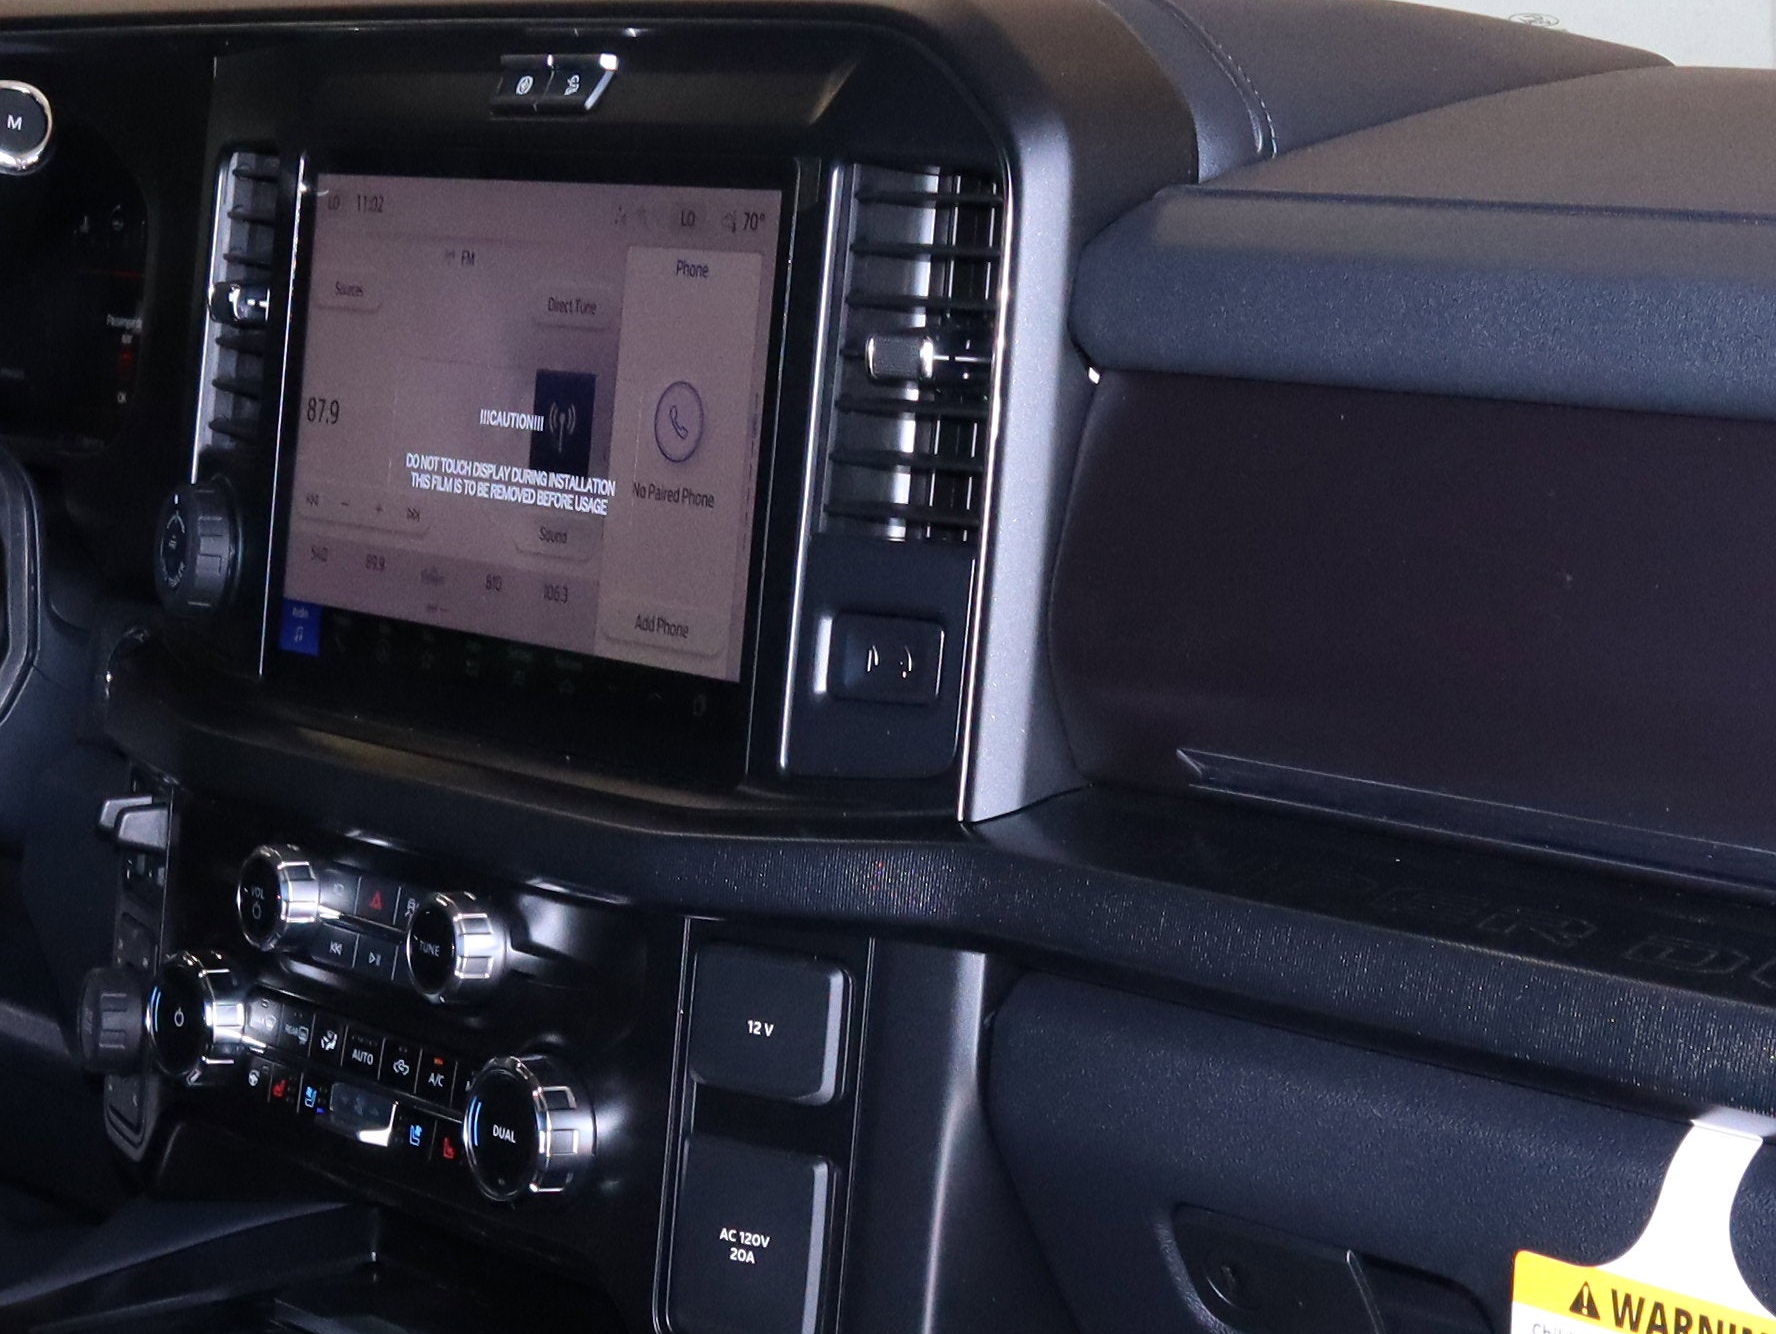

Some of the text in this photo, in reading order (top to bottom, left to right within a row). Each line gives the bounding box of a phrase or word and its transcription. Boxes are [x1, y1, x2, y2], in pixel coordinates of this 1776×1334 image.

[6, 113, 23, 131] M
[357, 194, 384, 213] 11:02
[680, 210, 696, 228] LO
[461, 249, 476, 267] FM
[675, 259, 710, 279] Phone
[334, 280, 364, 298] Sources
[547, 296, 597, 316] Direct Tune
[305, 396, 341, 426] 87.9
[406, 452, 616, 497] DO NOT TOUCH DISPLAY DURING INSTALLATION
[411, 470, 609, 516] THIS FILM IS TO BE REMOVED BEFORE USAGE
[632, 481, 716, 509] No Paired Phone
[539, 526, 568, 545] Sound
[634, 613, 690, 640] Add Phone
[250, 886, 265, 900] VOL
[418, 940, 441, 958] TUNE
[746, 1020, 774, 1037] 12 V
[351, 1048, 375, 1066] AUTO
[428, 1071, 446, 1088] A/C
[492, 1123, 517, 1144] DUAL
[718, 1227, 771, 1249] AC 120V
[728, 1247, 756, 1265] 20A
